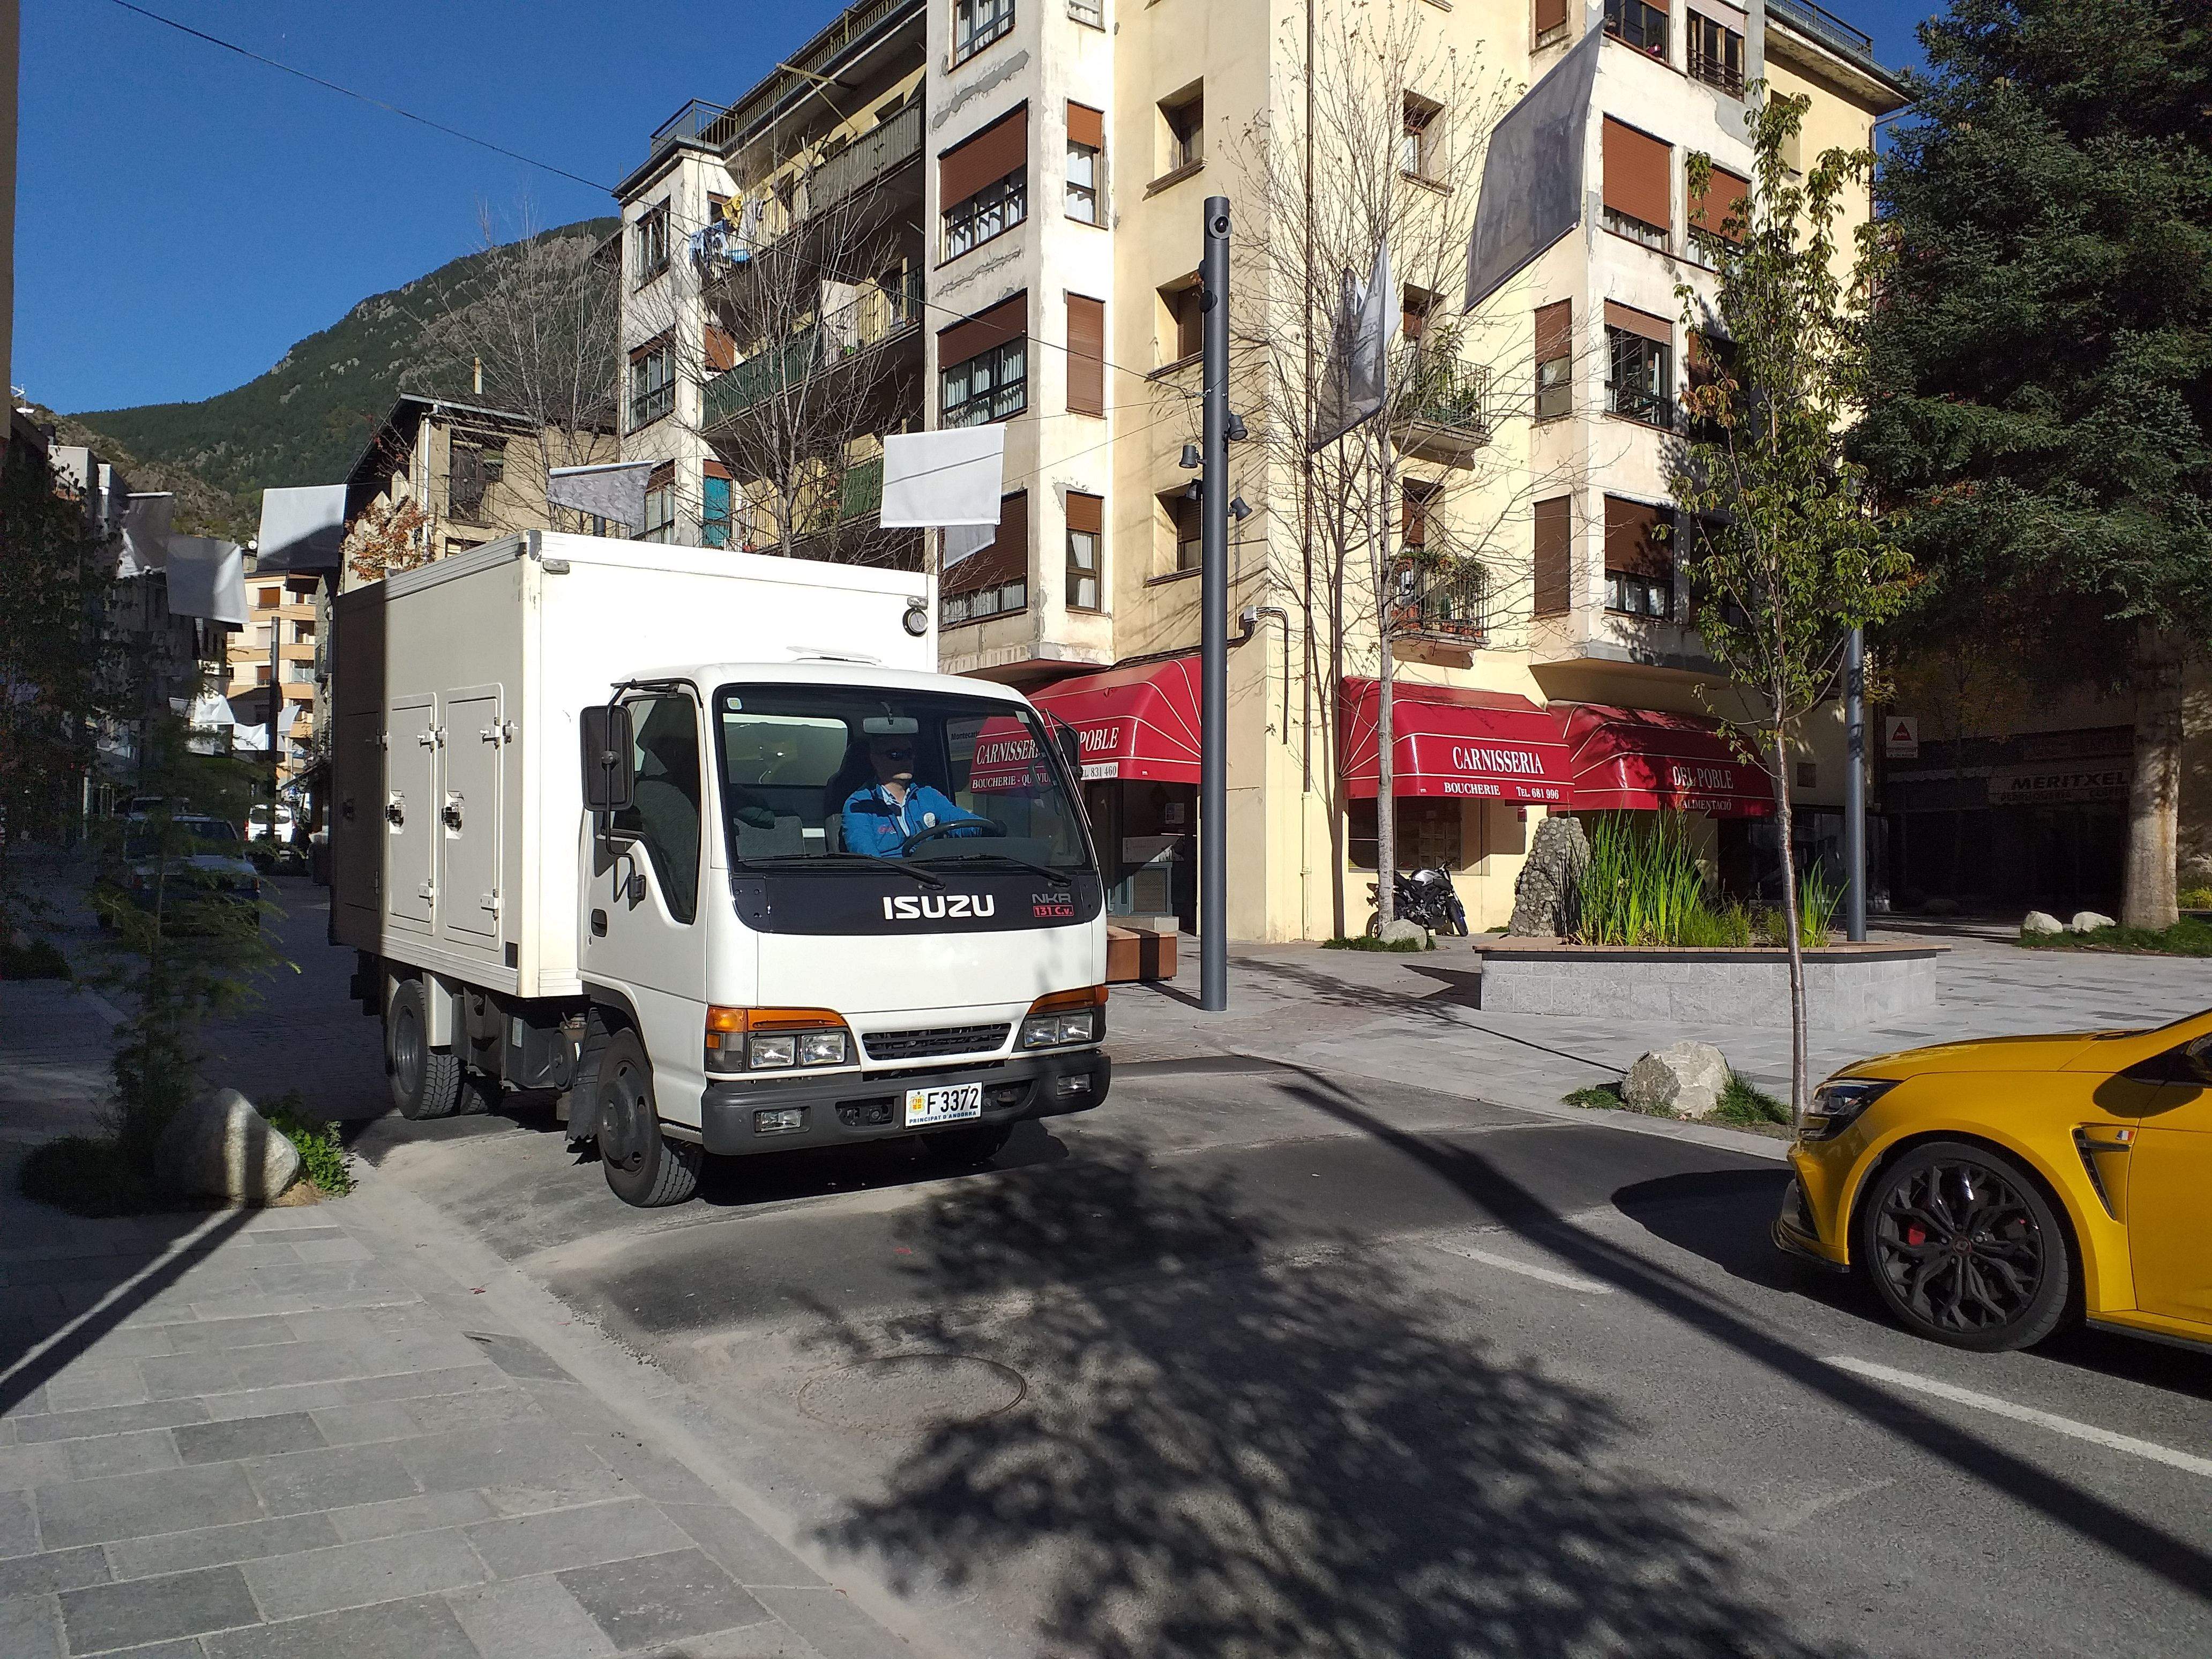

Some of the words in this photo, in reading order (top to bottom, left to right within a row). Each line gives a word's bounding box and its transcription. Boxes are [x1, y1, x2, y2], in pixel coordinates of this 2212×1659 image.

[976, 739, 1041, 765] CARNISSER
[1080, 727, 1119, 752] POBLE
[1453, 746, 1545, 774] CARNISSERIA
[972, 775, 1016, 789] BOUCHERIE
[1090, 767, 1102, 777] 831
[1104, 765, 1116, 776] 460
[1672, 766, 1696, 786] DEL
[1697, 767, 1733, 789] POBLE
[1444, 782, 1500, 795] BOUCHERIE
[1531, 788, 1544, 798] 681
[1546, 789, 1559, 799] 996
[1683, 798, 1731, 811] ALIMENTACIÓ
[883, 894, 995, 920] ISUZU
[1032, 893, 1072, 904] NKR
[1035, 906, 1052, 916] 131
[927, 1087, 978, 1115] F3372
[909, 1115, 941, 1124] PRINCIPAT
